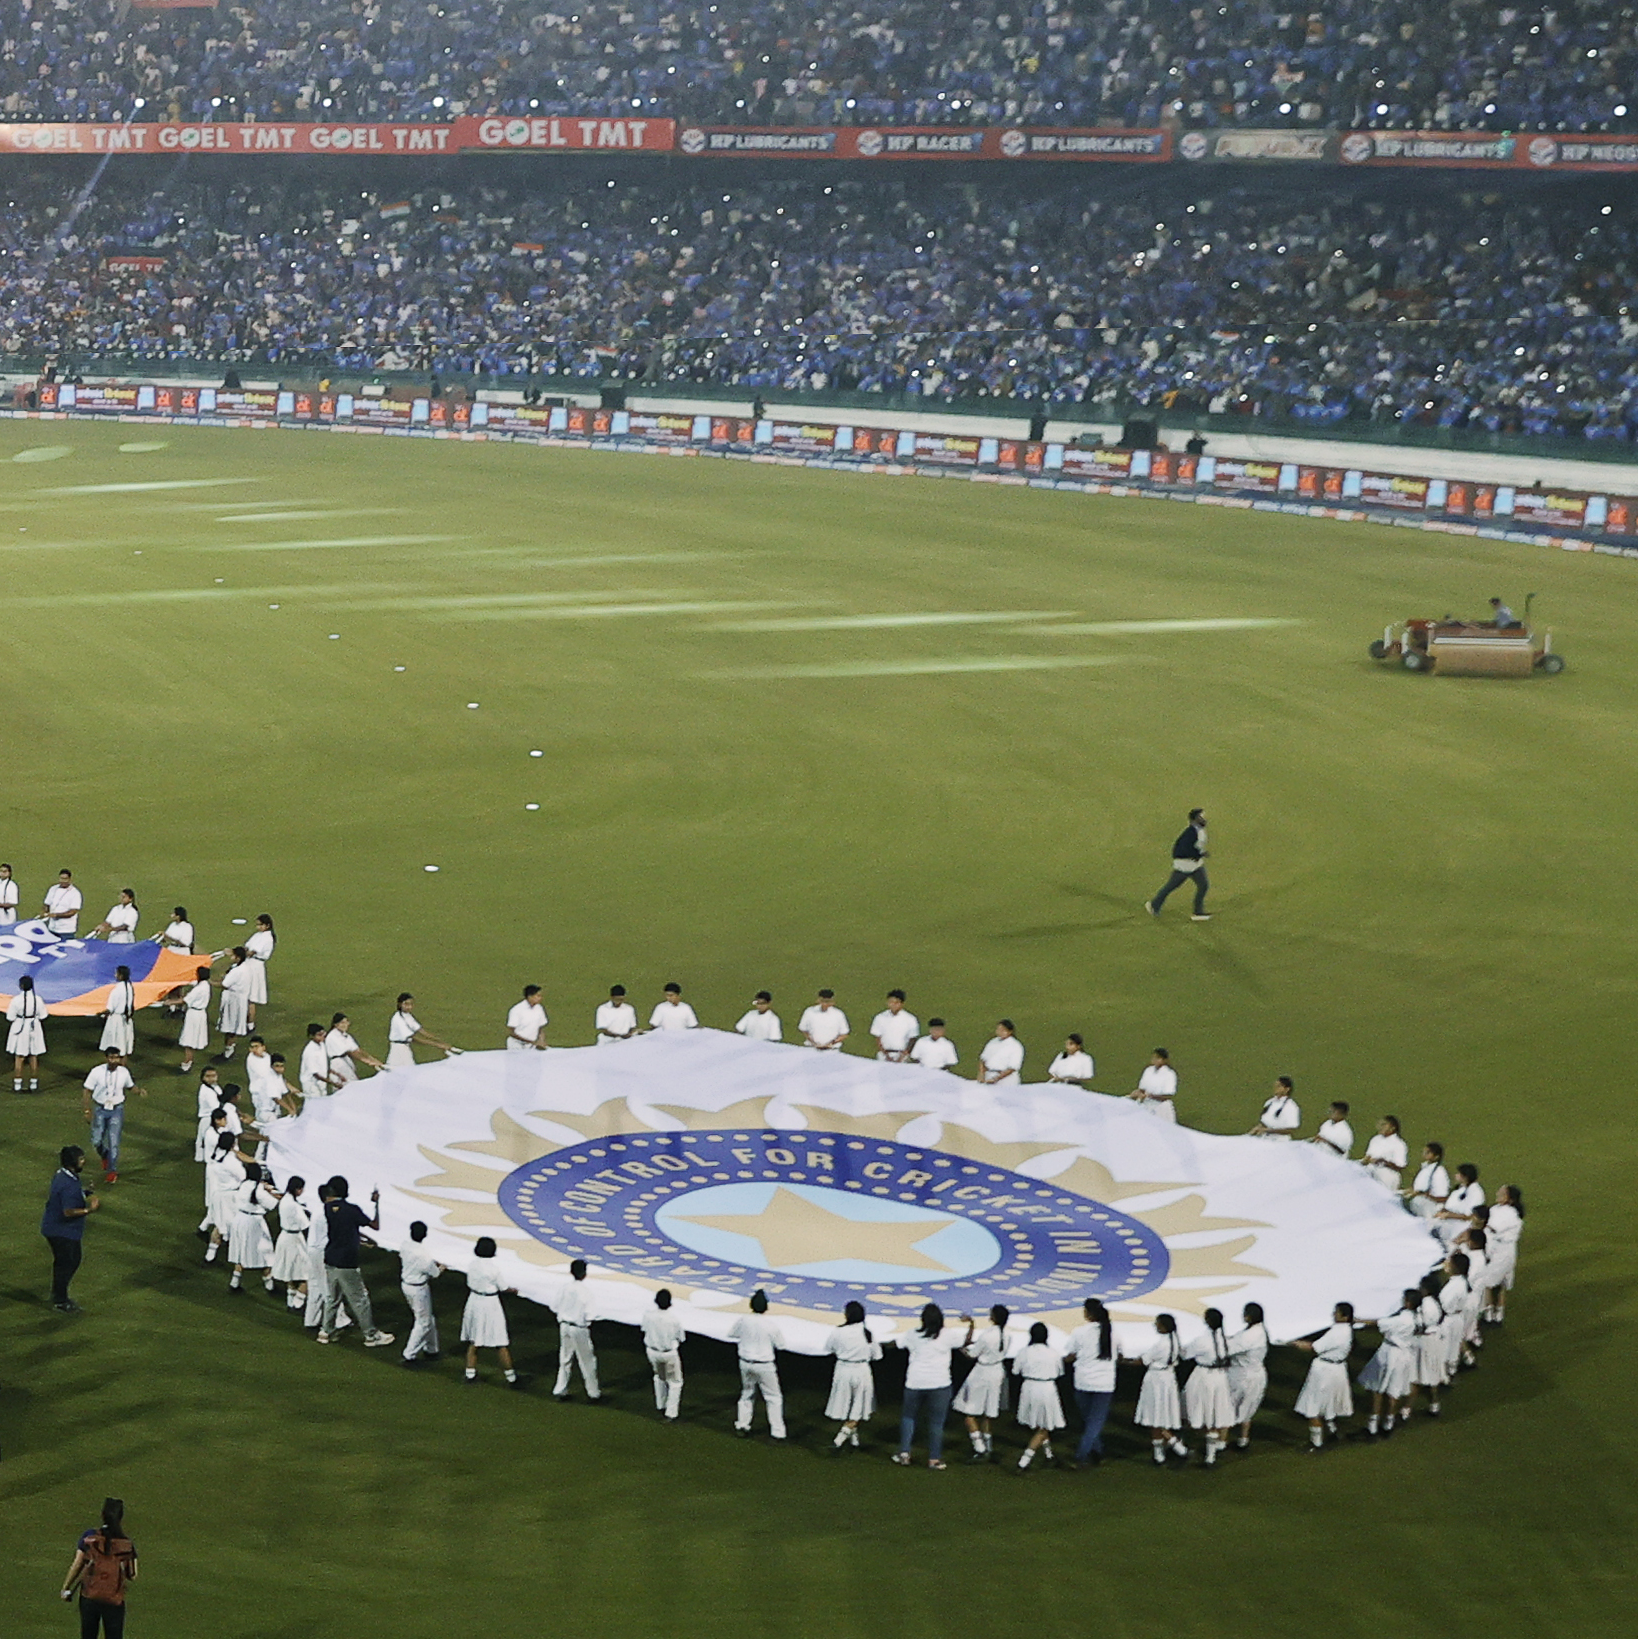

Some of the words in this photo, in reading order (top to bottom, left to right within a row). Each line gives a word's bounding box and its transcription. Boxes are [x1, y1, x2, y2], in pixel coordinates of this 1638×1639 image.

[12, 128, 83, 150] GOEL
[91, 128, 147, 149] TMT
[158, 127, 230, 149] GOEL
[239, 128, 296, 149] TMT
[309, 127, 383, 150] GOEL
[392, 128, 450, 150] TMT
[478, 119, 568, 146] GOEL
[578, 120, 648, 147] TMT
[711, 134, 735, 149] HP
[738, 134, 830, 151] LUBRICANTS
[888, 135, 913, 150] HP
[916, 136, 972, 151] RACER
[1032, 136, 1058, 152] HP
[1060, 137, 1154, 154] LUBRICANTS
[731, 1148, 834, 1171] FOR
[559, 1151, 720, 1213] CONTROL
[862, 1161, 1073, 1224] CRICKET
[563, 1215, 616, 1238] OF
[1049, 1231, 1102, 1253] IN
[602, 1244, 788, 1293] BOARD
[992, 1261, 1102, 1298] INDIA
